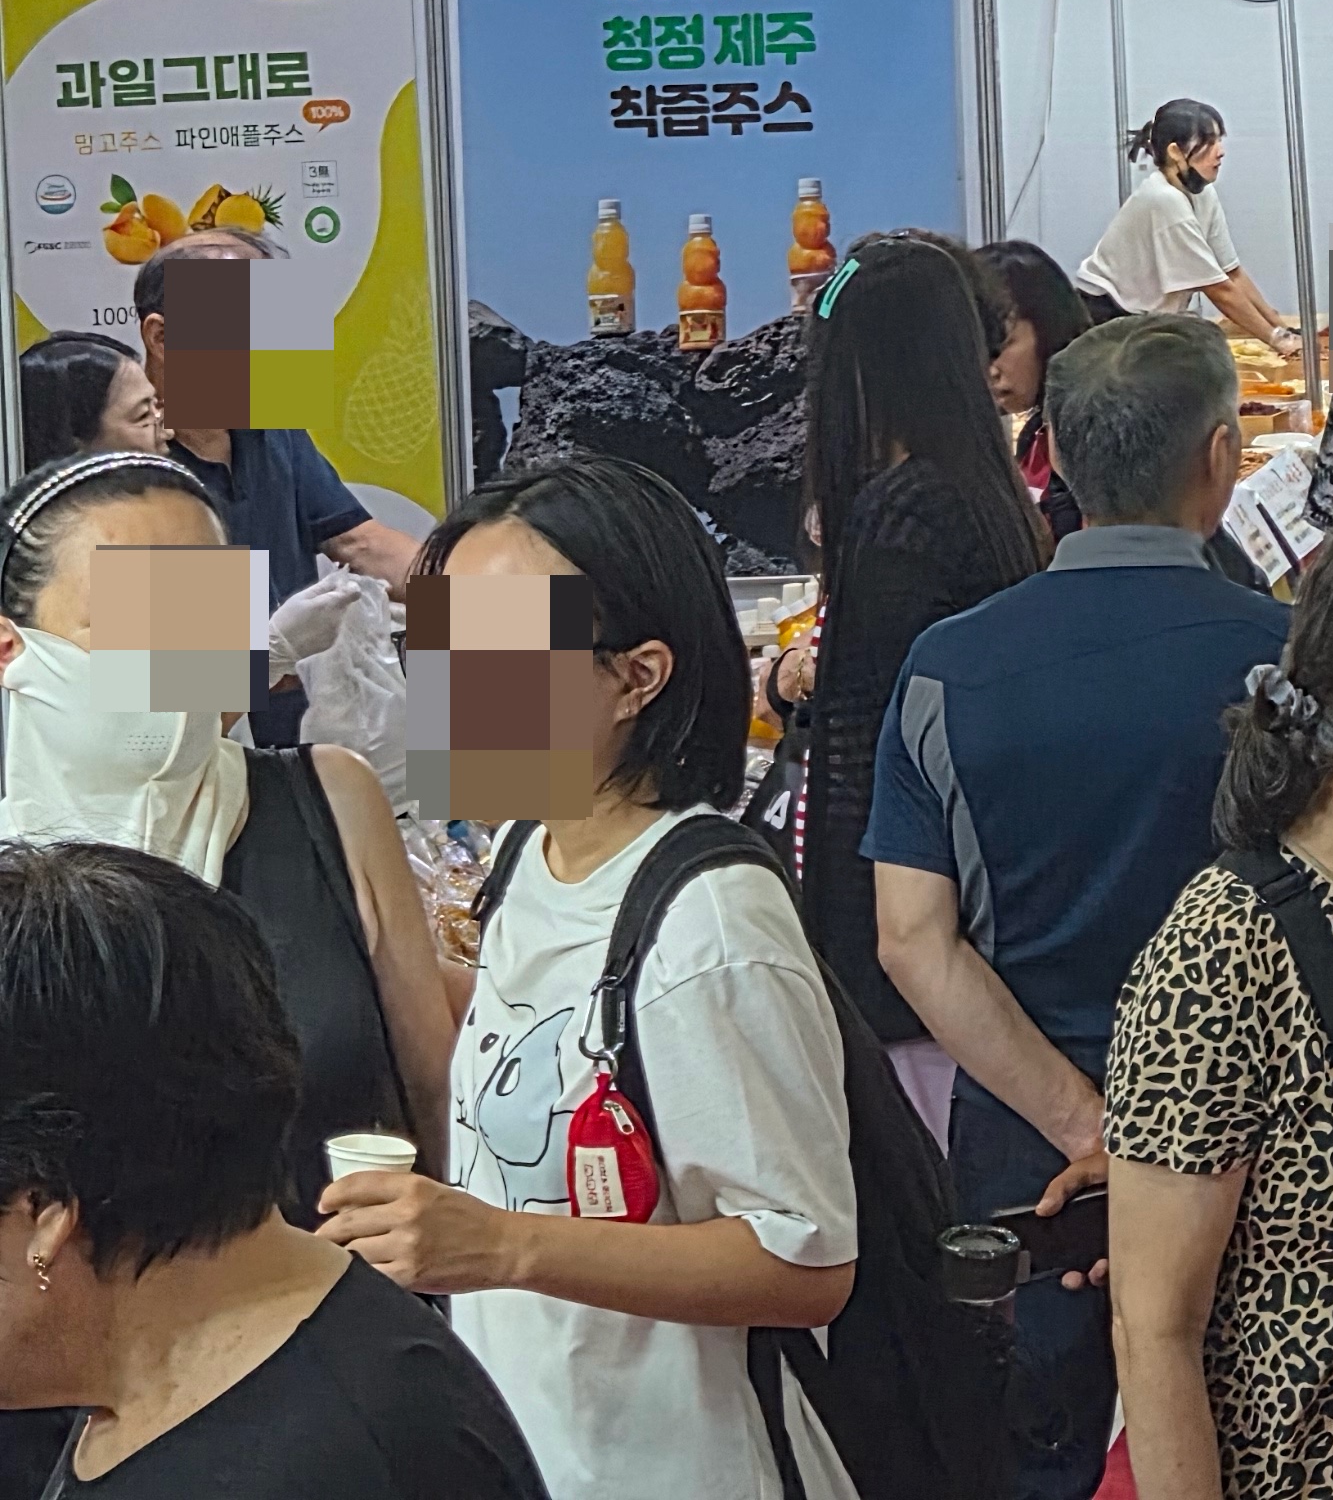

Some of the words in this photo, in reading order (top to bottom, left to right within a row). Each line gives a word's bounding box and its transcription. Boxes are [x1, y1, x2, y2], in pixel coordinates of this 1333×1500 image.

[603, 13, 706, 71] 청정
[713, 12, 816, 66] 제주
[56, 51, 312, 108] 과일그대로
[174, 123, 306, 150] 파인애플주스
[610, 81, 814, 138] 착즙주스
